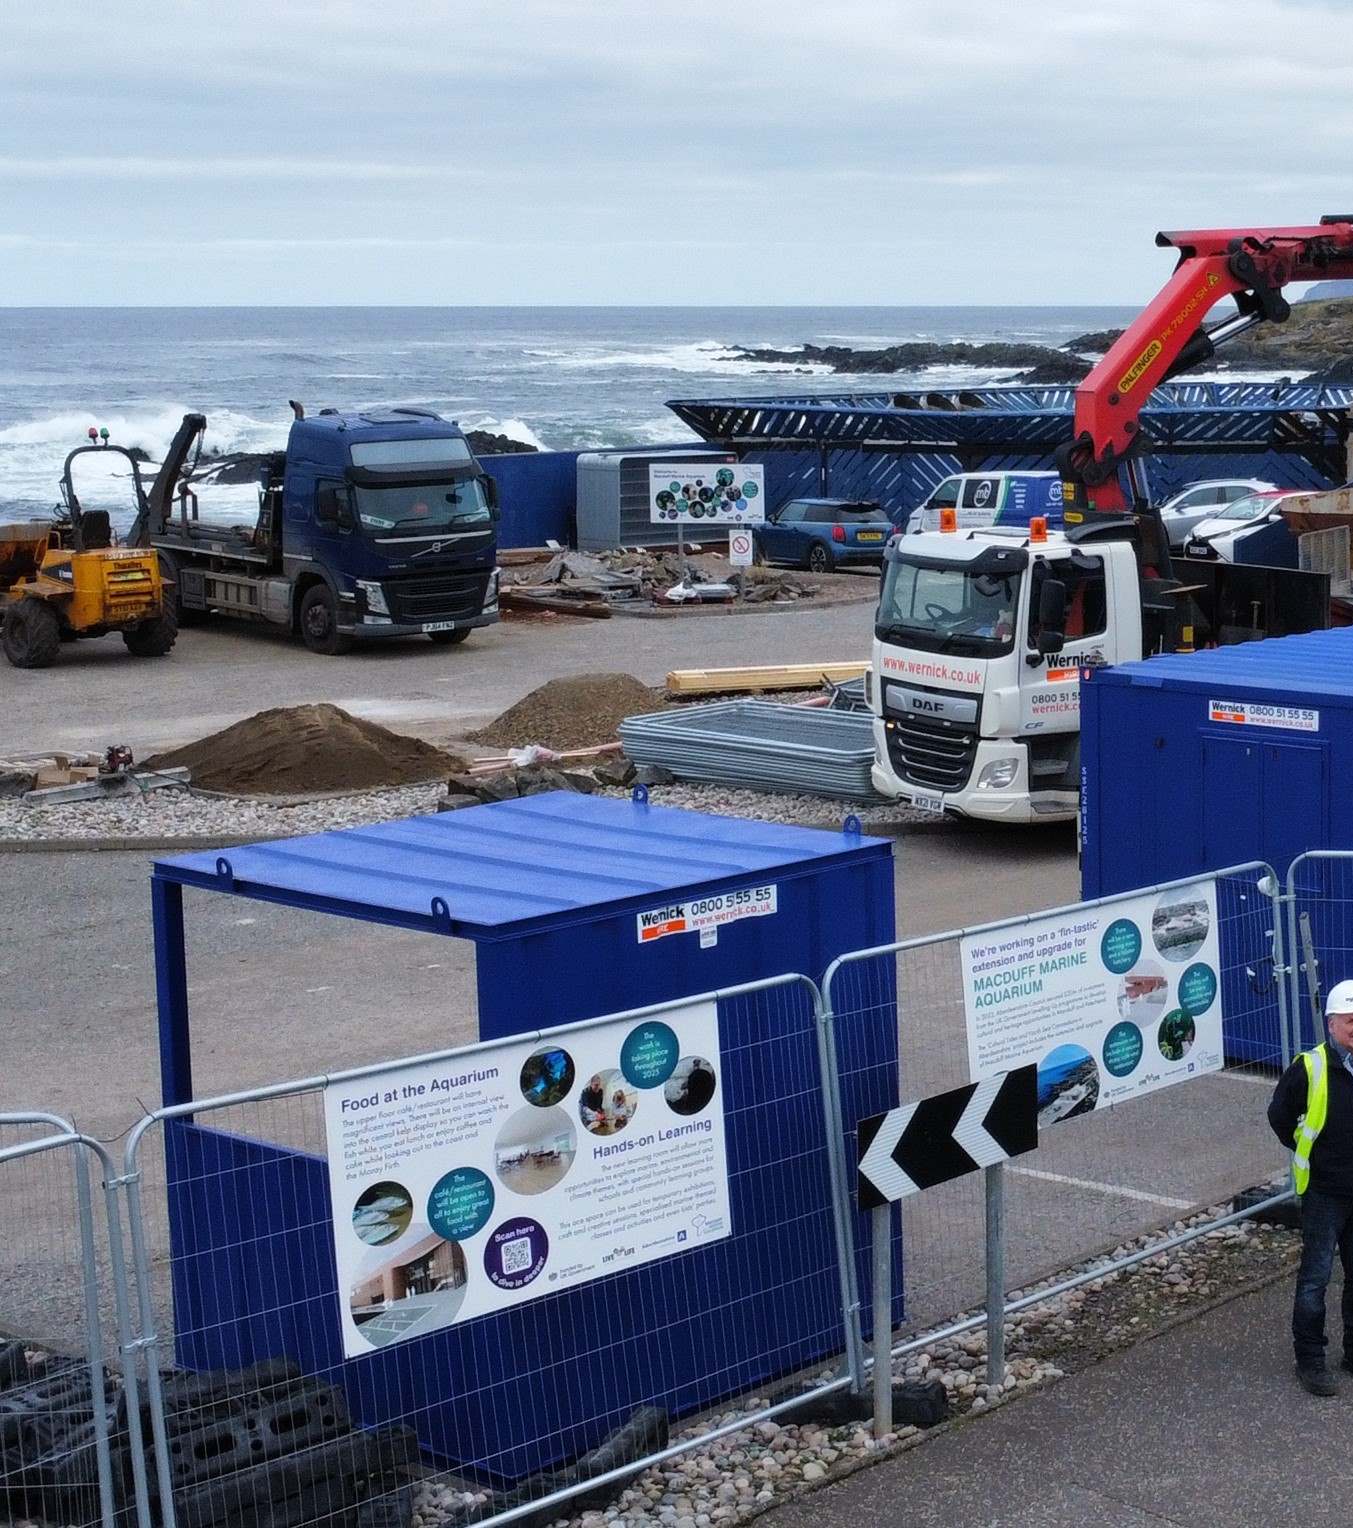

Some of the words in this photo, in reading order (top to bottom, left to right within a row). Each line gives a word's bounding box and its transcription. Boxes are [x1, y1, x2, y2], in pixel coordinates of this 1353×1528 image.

[1120, 343, 1160, 390] PALFINGER
[883, 656, 981, 685] www.wernick.co.uk
[912, 698, 944, 712] DAF
[1032, 694, 1057, 704] 0800
[1060, 693, 1069, 702] 51
[1032, 703, 1080, 714] wernick.c
[1212, 702, 1246, 713] Wernick
[1249, 706, 1274, 716] 0800
[1276, 708, 1286, 717] 51
[1288, 710, 1300, 719] 55
[1302, 711, 1314, 720] 55
[691, 897, 723, 916] 0800
[756, 887, 771, 902] 55
[972, 957, 1015, 974] extension
[1018, 951, 1034, 962] and
[1036, 942, 1072, 958] upgrade
[1074, 938, 1086, 948] for
[999, 938, 1034, 952] working
[1037, 935, 1048, 943] on
[974, 966, 1035, 992] MACDUFF
[1039, 953, 1086, 975] MARINE
[975, 981, 1043, 1008] AQUARIUM
[341, 1093, 379, 1112] Food
[384, 1089, 398, 1103] at
[402, 1085, 425, 1098] the
[430, 1069, 498, 1092] Aquarium
[593, 1135, 654, 1159] Hands-on
[658, 1120, 712, 1141] Learning
[495, 1231, 516, 1242] Scan
[516, 1226, 535, 1236] here
[498, 1278, 514, 1287] dive
